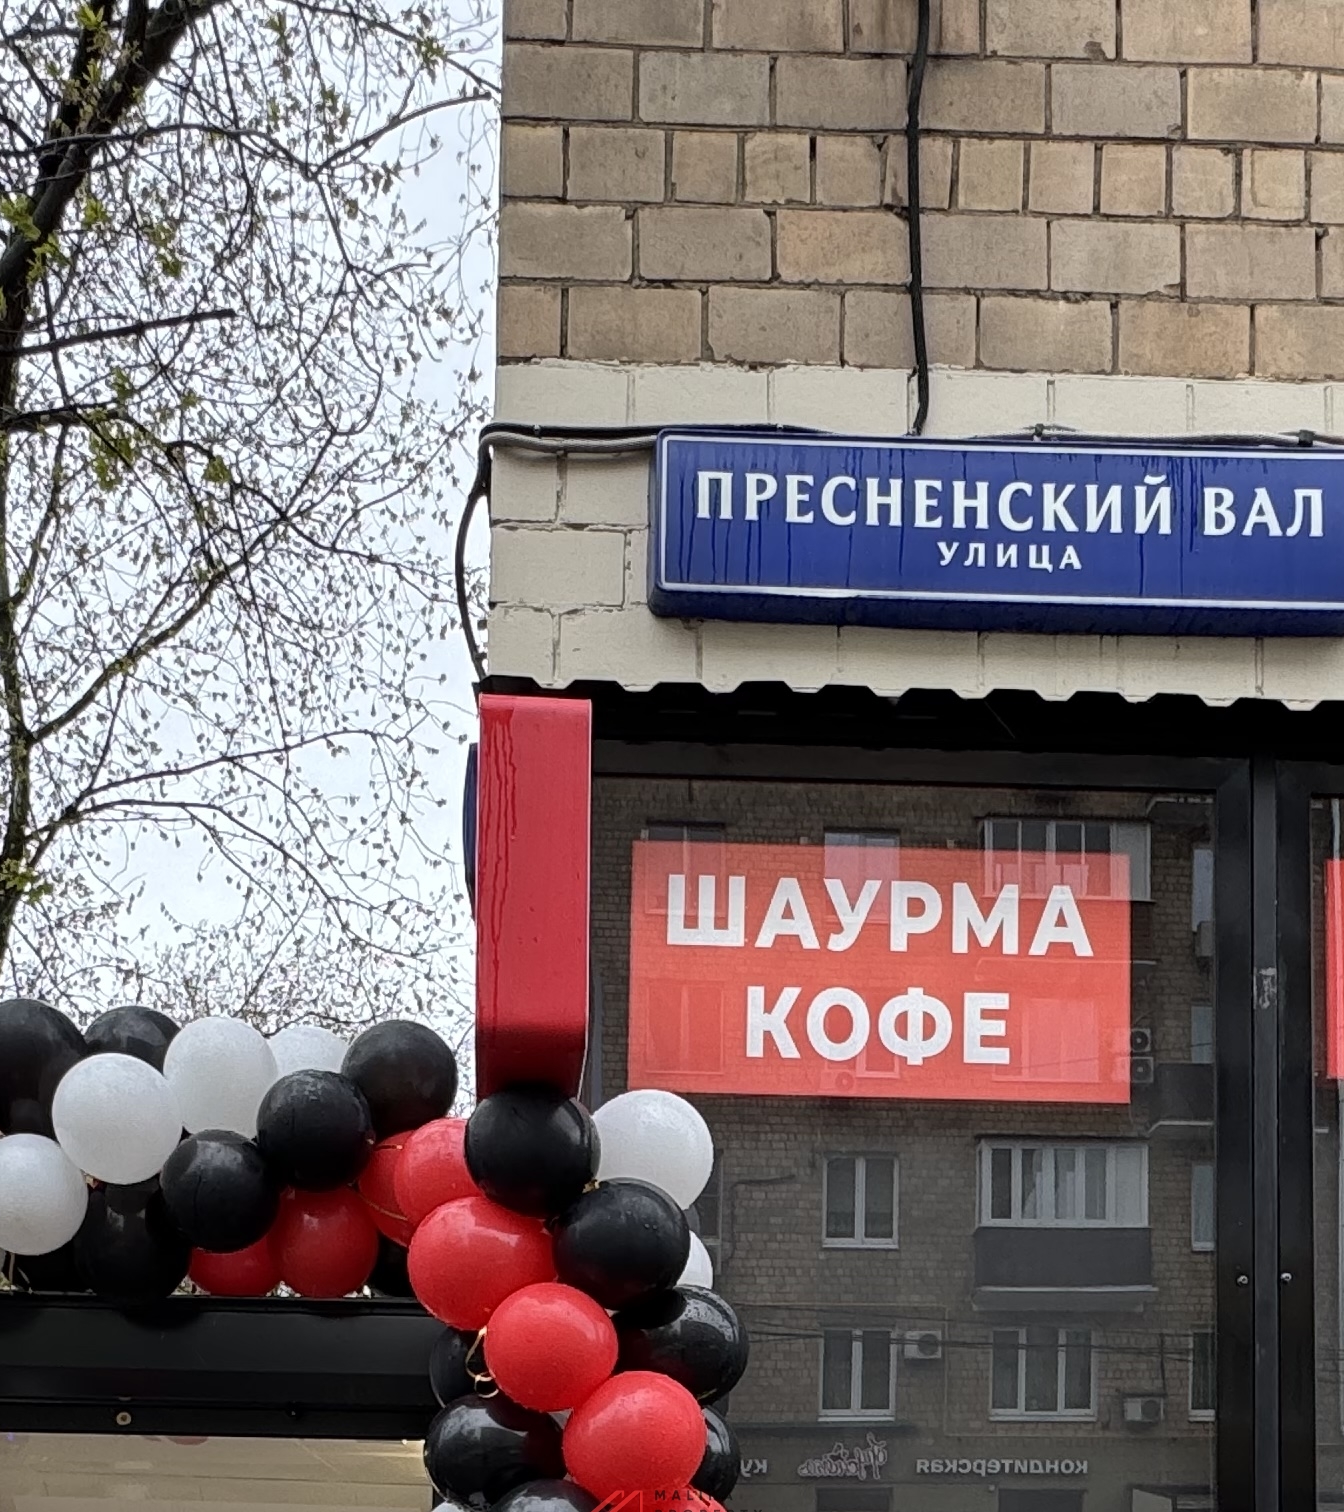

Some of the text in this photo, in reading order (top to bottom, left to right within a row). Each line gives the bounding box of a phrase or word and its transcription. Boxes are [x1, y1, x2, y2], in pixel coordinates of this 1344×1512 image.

[695, 470, 1326, 537] ПРЕСНЕНСКИЙ ВАЛ
[937, 540, 1083, 571] УЛИЦА
[666, 874, 1094, 957] ШАУРМА
[745, 985, 1011, 1066] КОФЕ
